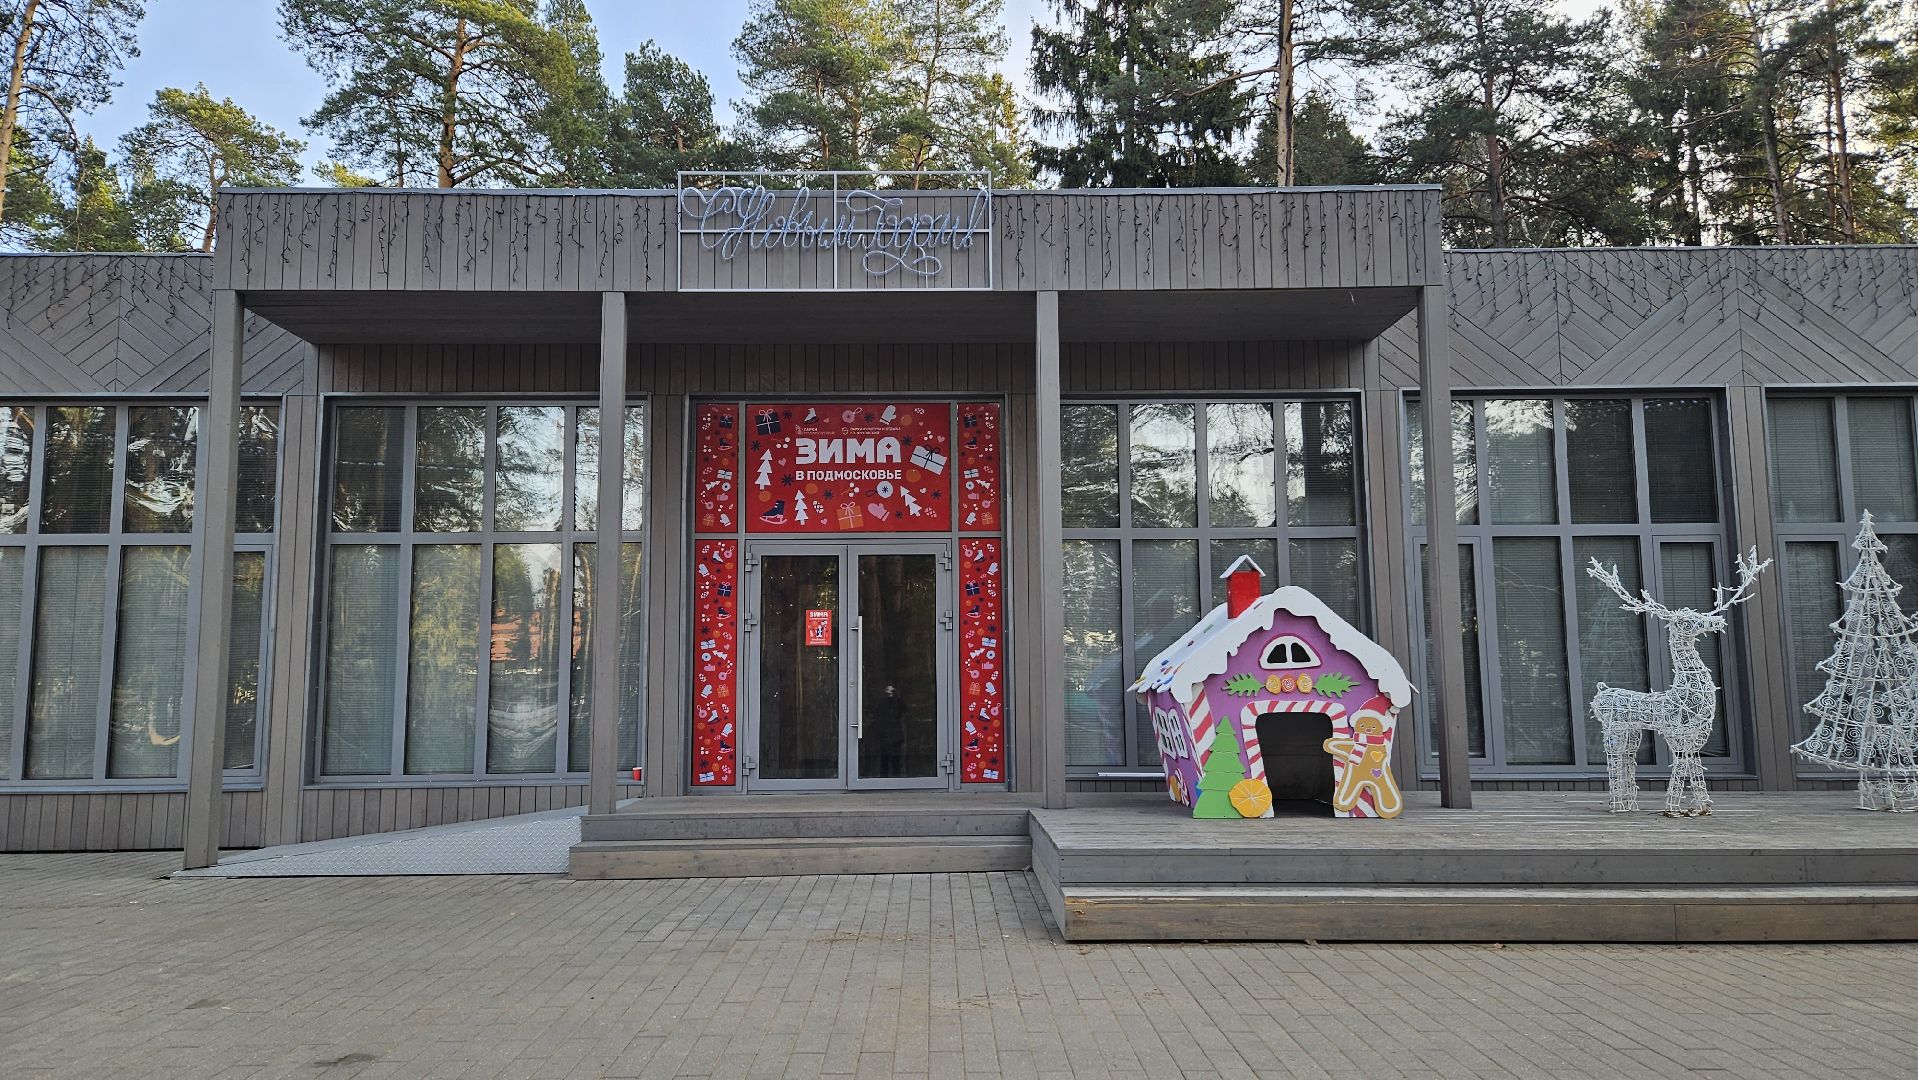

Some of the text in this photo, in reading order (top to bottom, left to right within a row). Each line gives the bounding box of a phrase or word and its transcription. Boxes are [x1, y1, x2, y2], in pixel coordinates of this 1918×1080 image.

[795, 437, 902, 465] ЗИМА
[795, 469, 902, 482] В ПОДМОСКОВЬЕ
